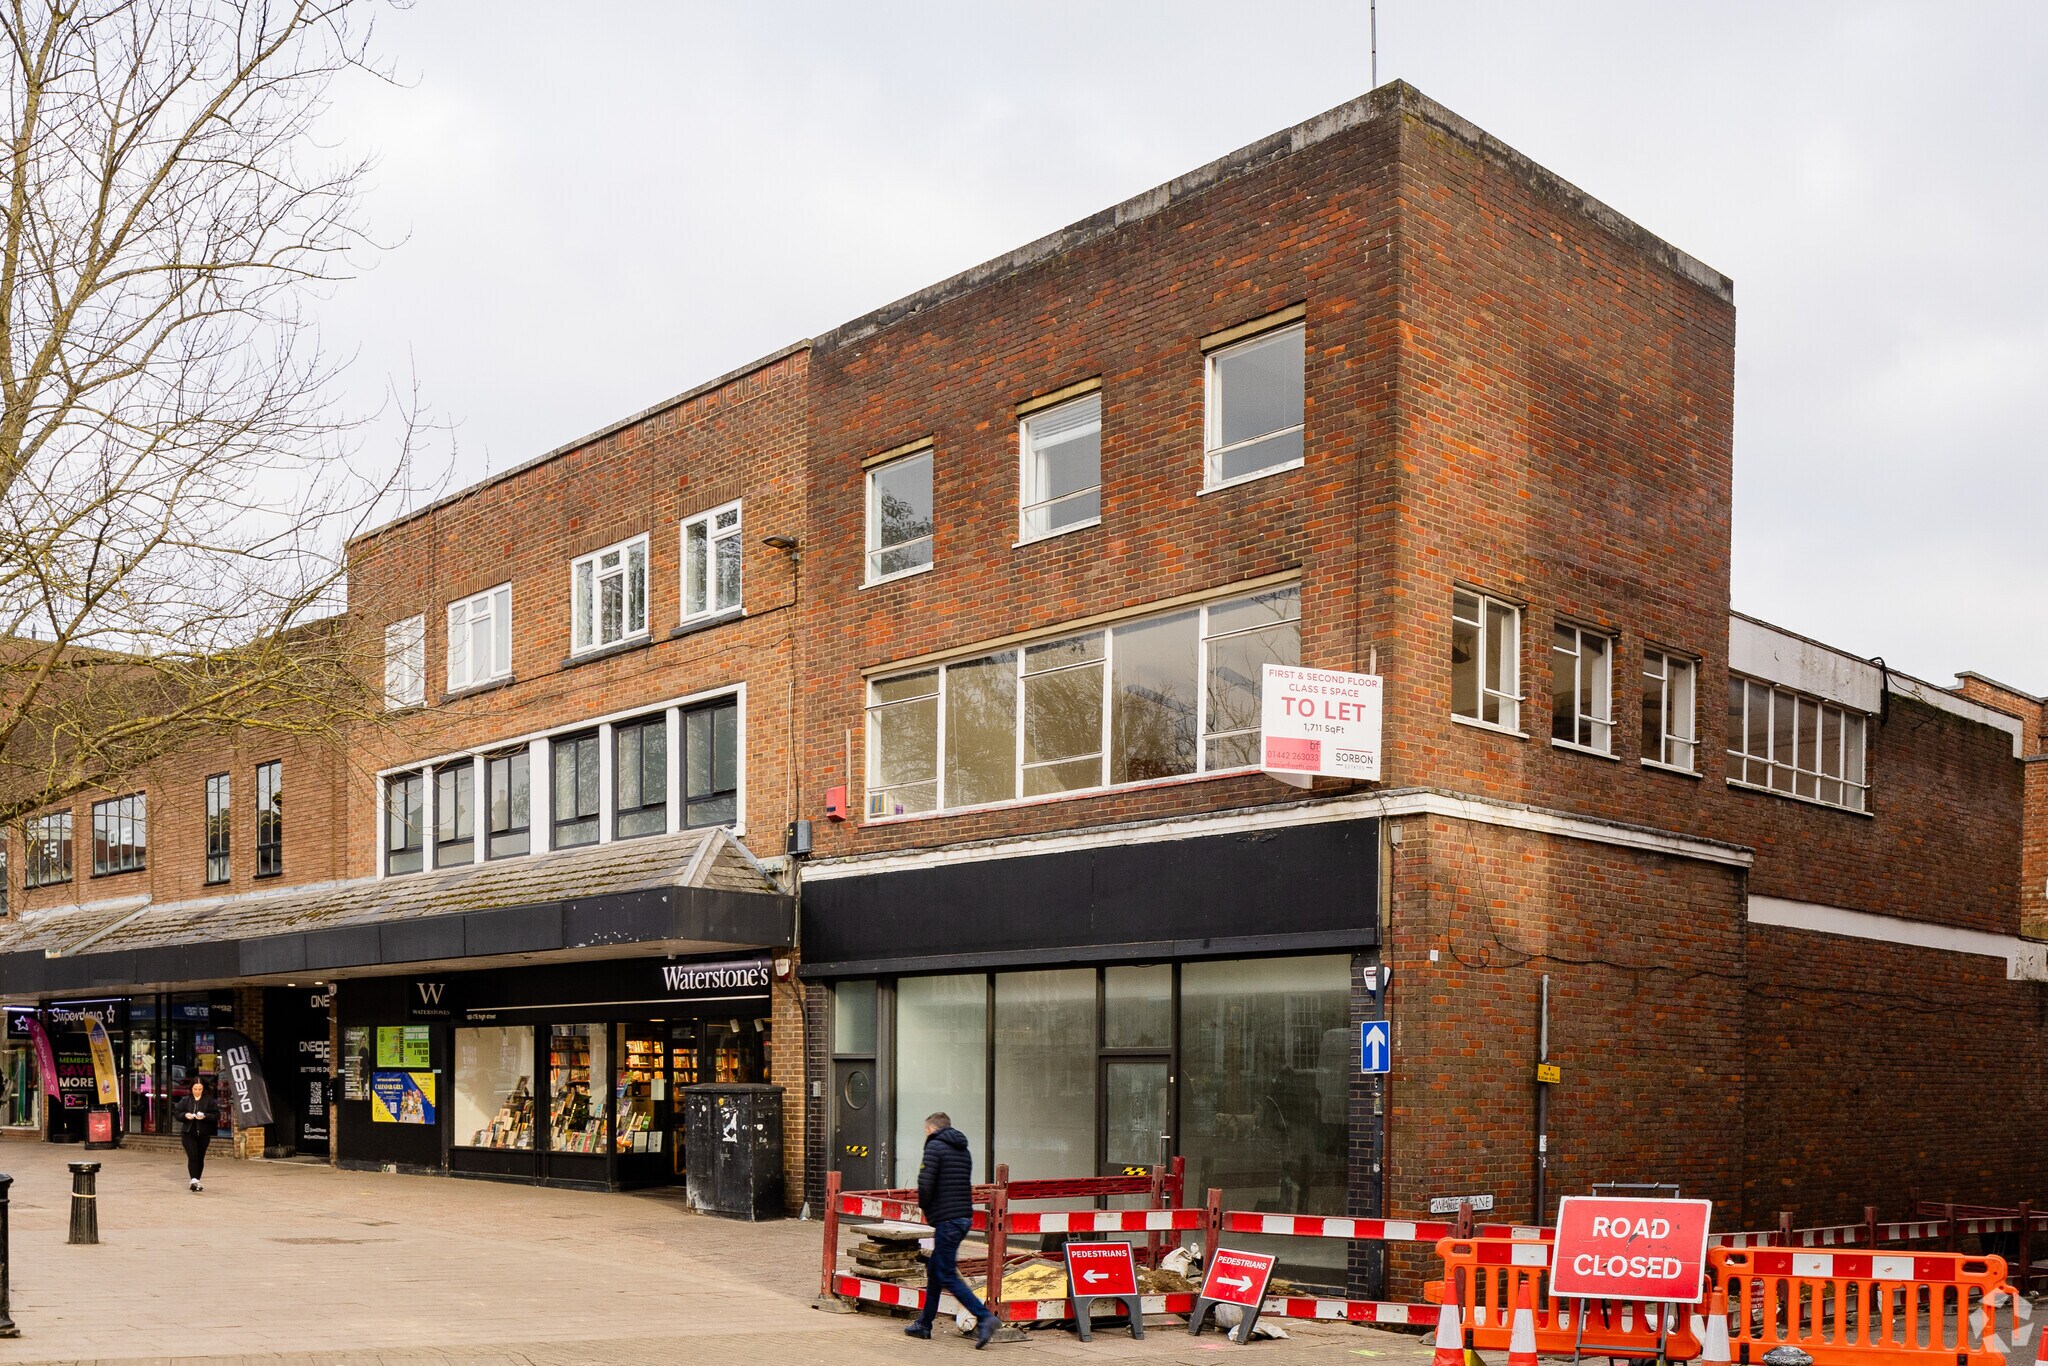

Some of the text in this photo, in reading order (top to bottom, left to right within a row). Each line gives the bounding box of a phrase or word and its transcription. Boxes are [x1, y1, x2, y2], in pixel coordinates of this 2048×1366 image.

[1269, 669, 1378, 688] FIRST & SECOND FLOOR
[1289, 683, 1359, 698] CLASS E SPACE
[1281, 696, 1366, 723] TO LET
[1303, 723, 1345, 734] 1,711 SqFt
[1310, 740, 1321, 751] bf
[1267, 751, 1319, 762] 01442 263033
[1335, 752, 1374, 764] SORBON
[661, 960, 770, 991] Waterstone's
[416, 982, 446, 1005] W
[59, 1064, 94, 1077] SAVE
[59, 1077, 94, 1088] MORE
[226, 1046, 253, 1113] ONE92
[1592, 1216, 1670, 1241] ROAD
[1071, 1249, 1128, 1258] PEDESTRIANS
[1217, 1255, 1267, 1271] PEDESTRIANS
[1572, 1253, 1682, 1279] CLOSED
